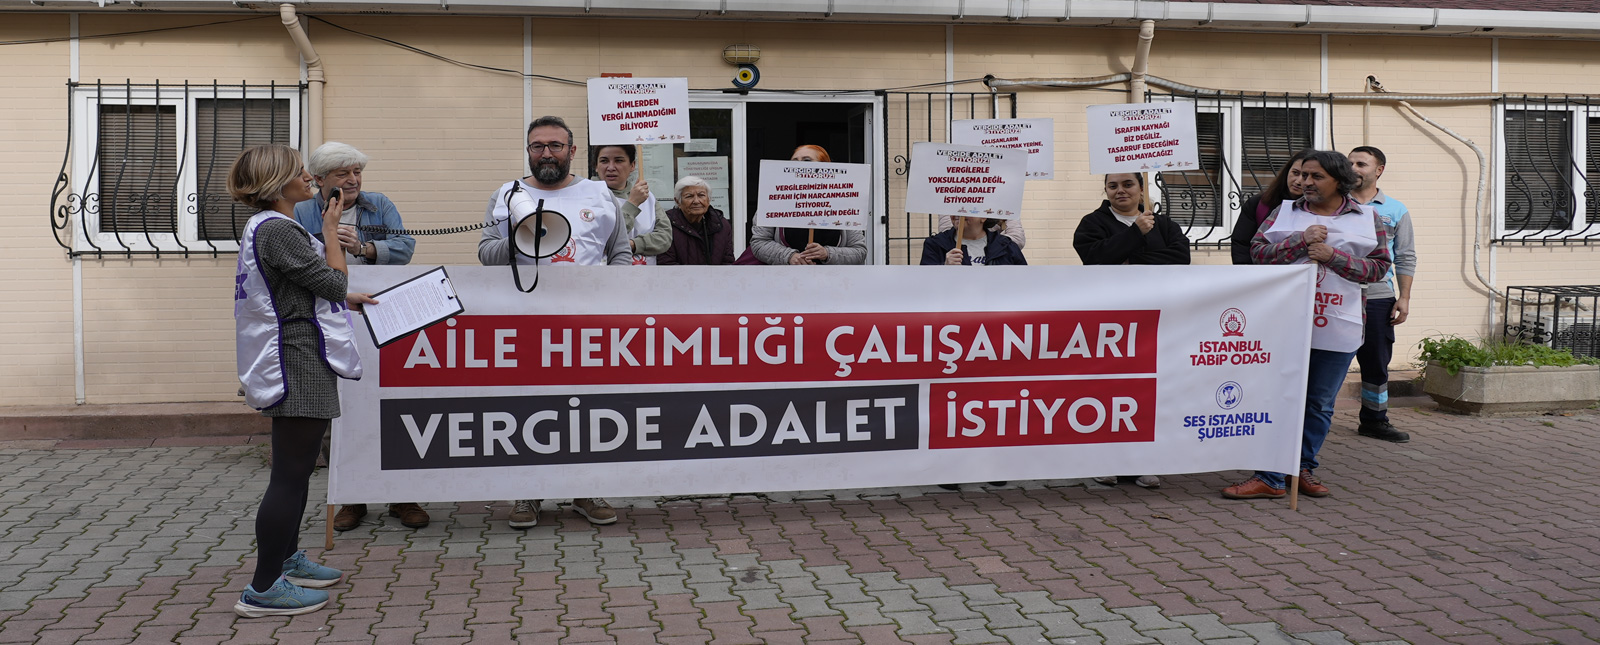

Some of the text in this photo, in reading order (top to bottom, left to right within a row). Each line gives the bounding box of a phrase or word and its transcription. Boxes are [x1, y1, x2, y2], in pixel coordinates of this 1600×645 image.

[617, 99, 659, 109] KİMLERDEN
[602, 108, 676, 121] VERGİ ALINMADIĞINI
[620, 120, 658, 131] BİLİYORUZ
[1115, 121, 1170, 134] İSRAFIN KAYNAĞI
[1136, 132, 1162, 140] DEĞİLİZ.
[1108, 140, 1180, 154] TASARRUF EDECEĞİNİZ
[1126, 150, 1173, 160] OLMAYACAĞIZ!
[928, 176, 1006, 184] YOKSULLAŞMA DEĞİL,
[776, 183, 828, 192] VERGİLERİMİZİN
[794, 192, 807, 200] İÇİN
[808, 192, 859, 200] HARCANMASINI
[766, 210, 823, 218] SERMAYEDARLAR
[824, 210, 838, 218] İÇİN
[403, 316, 1138, 378] AİLE HEKİMLİĞİ ÇALIŞANLARI
[1199, 340, 1263, 352] İSTANBUL
[1190, 352, 1270, 366] TABİP ODASI
[400, 388, 1139, 460] VERGİDE ADALET İSTİYOR
[1184, 412, 1272, 428] SES İSTANBUL
[1198, 425, 1255, 442] ŞUBELERİ
